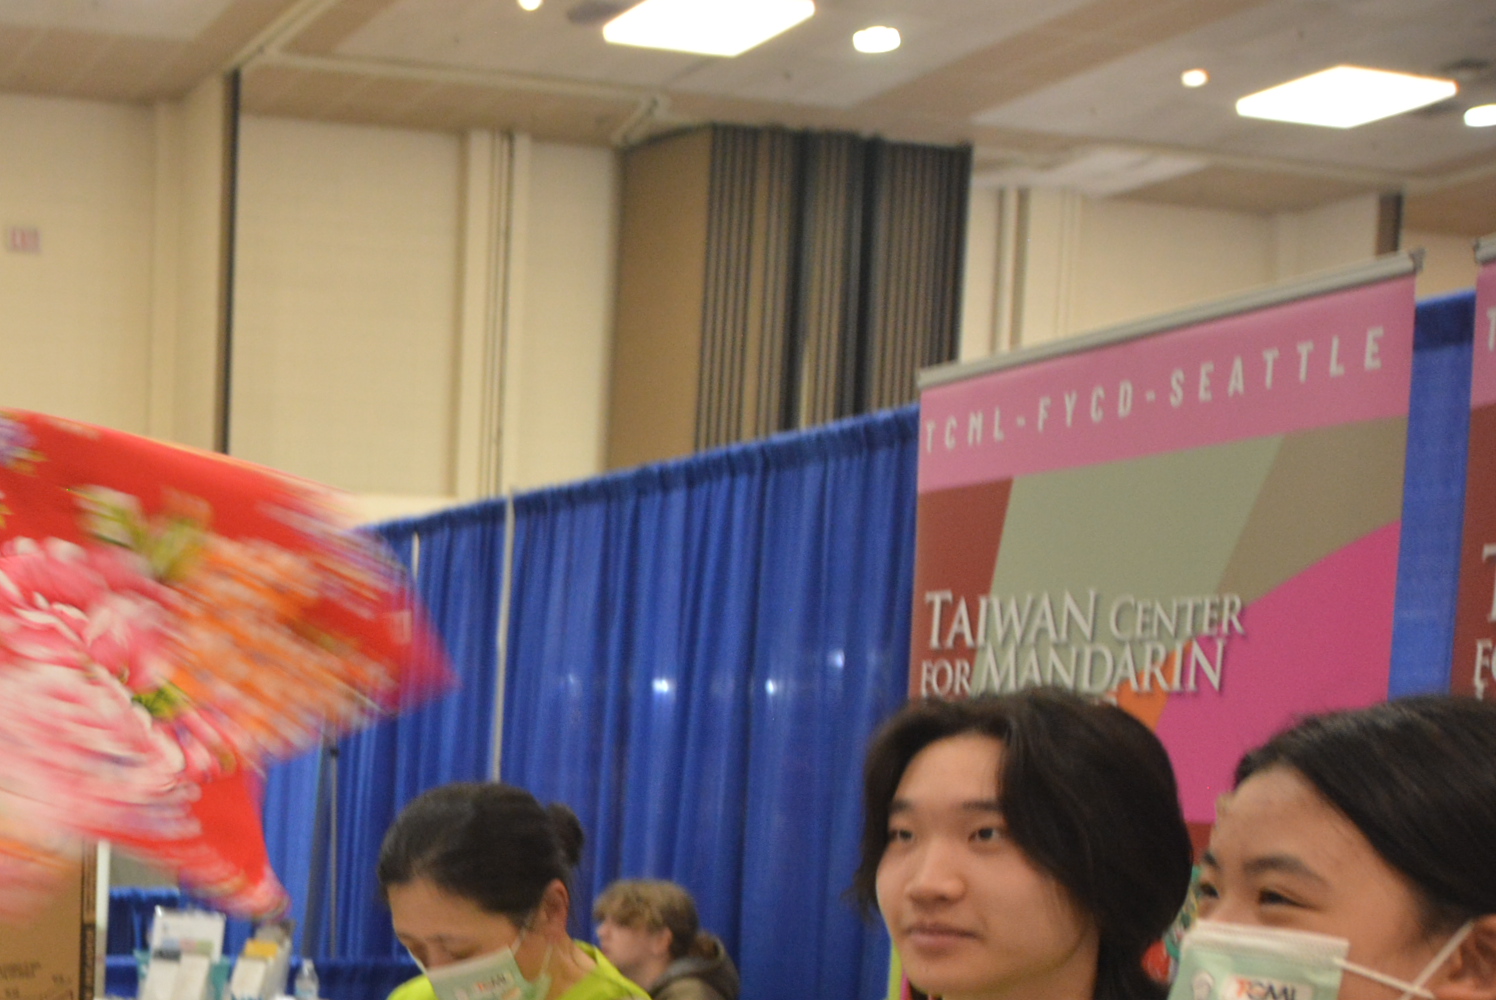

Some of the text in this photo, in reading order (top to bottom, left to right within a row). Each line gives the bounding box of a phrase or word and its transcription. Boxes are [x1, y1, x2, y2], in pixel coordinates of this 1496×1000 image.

[925, 588, 1246, 649] TAIWAN CENTER
[920, 637, 1226, 698] FOR MANDARIN
